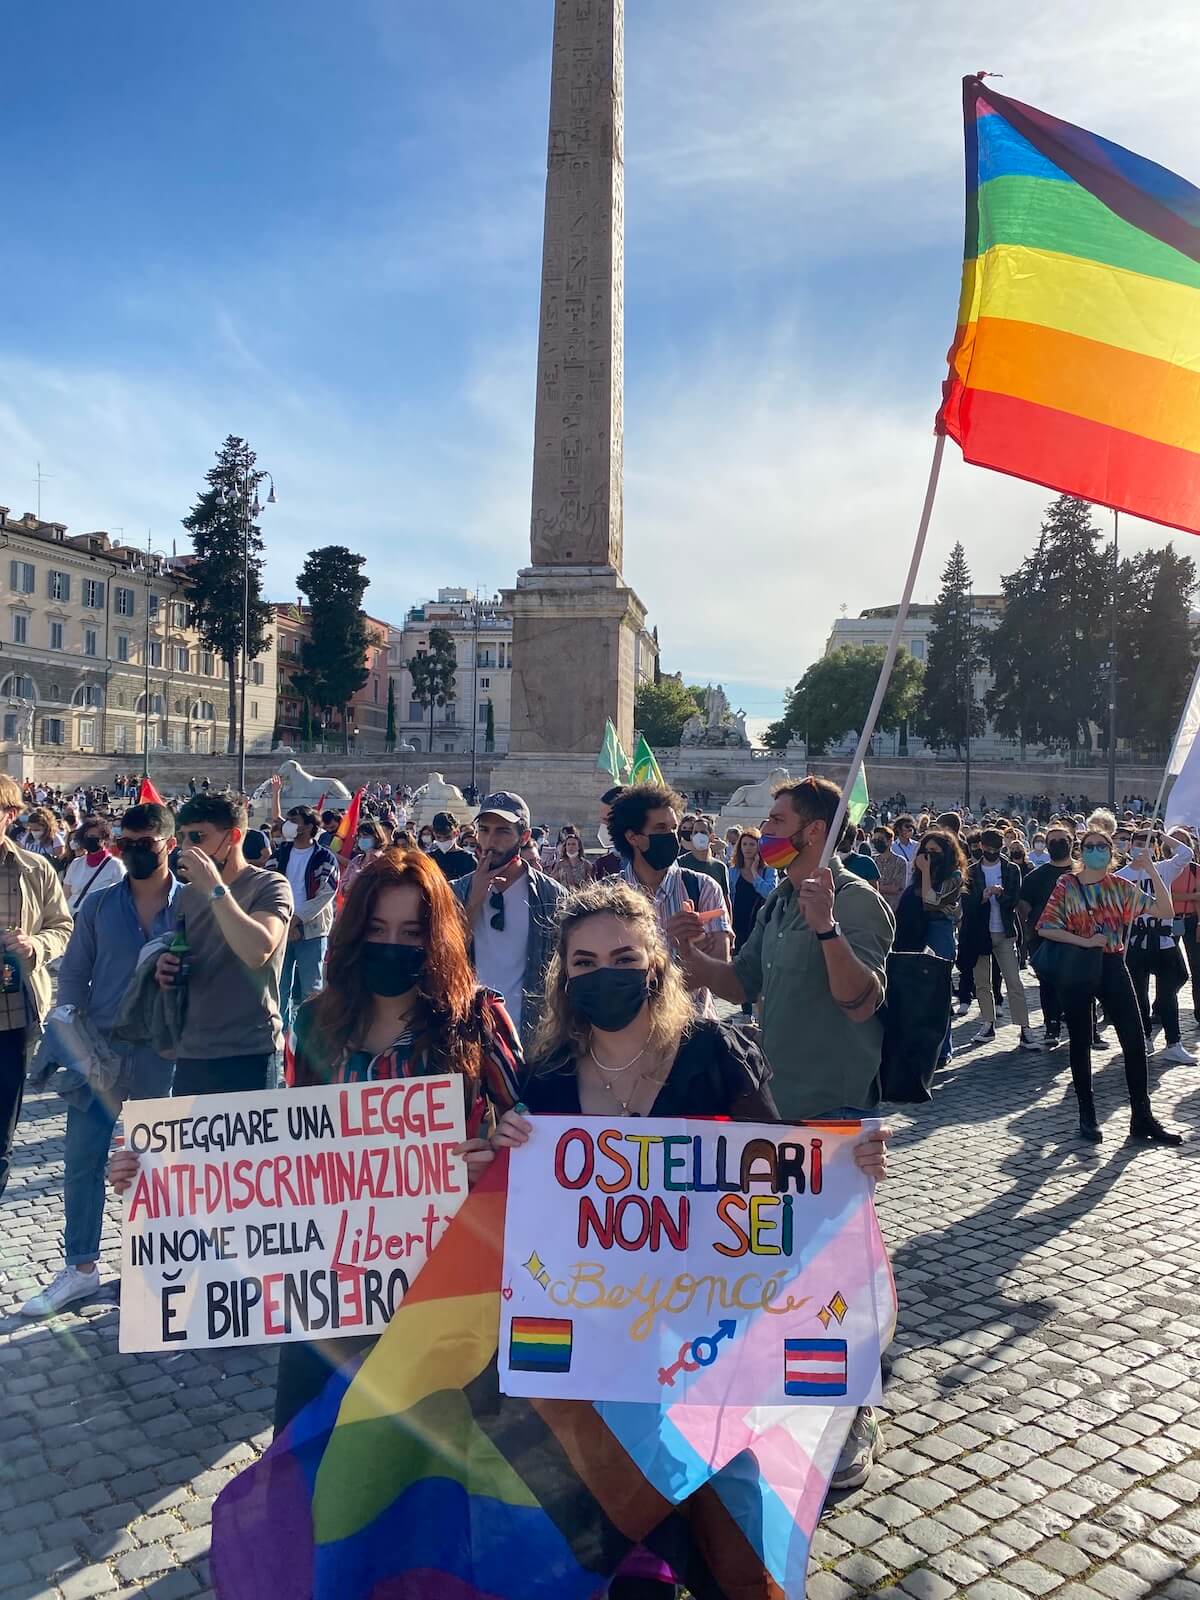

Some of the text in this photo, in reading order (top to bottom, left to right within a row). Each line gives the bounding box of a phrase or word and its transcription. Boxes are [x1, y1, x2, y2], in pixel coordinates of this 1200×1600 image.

[130, 1080, 455, 1153] OSTEGGIARE UNA LEGGE
[128, 1141, 461, 1222] ANTI-DISCRIMINAZIONE
[131, 1204, 454, 1274] IN NOME DELLA Libert
[577, 1195, 690, 1252] NON
[549, 1262, 814, 1342] Beyoncé
